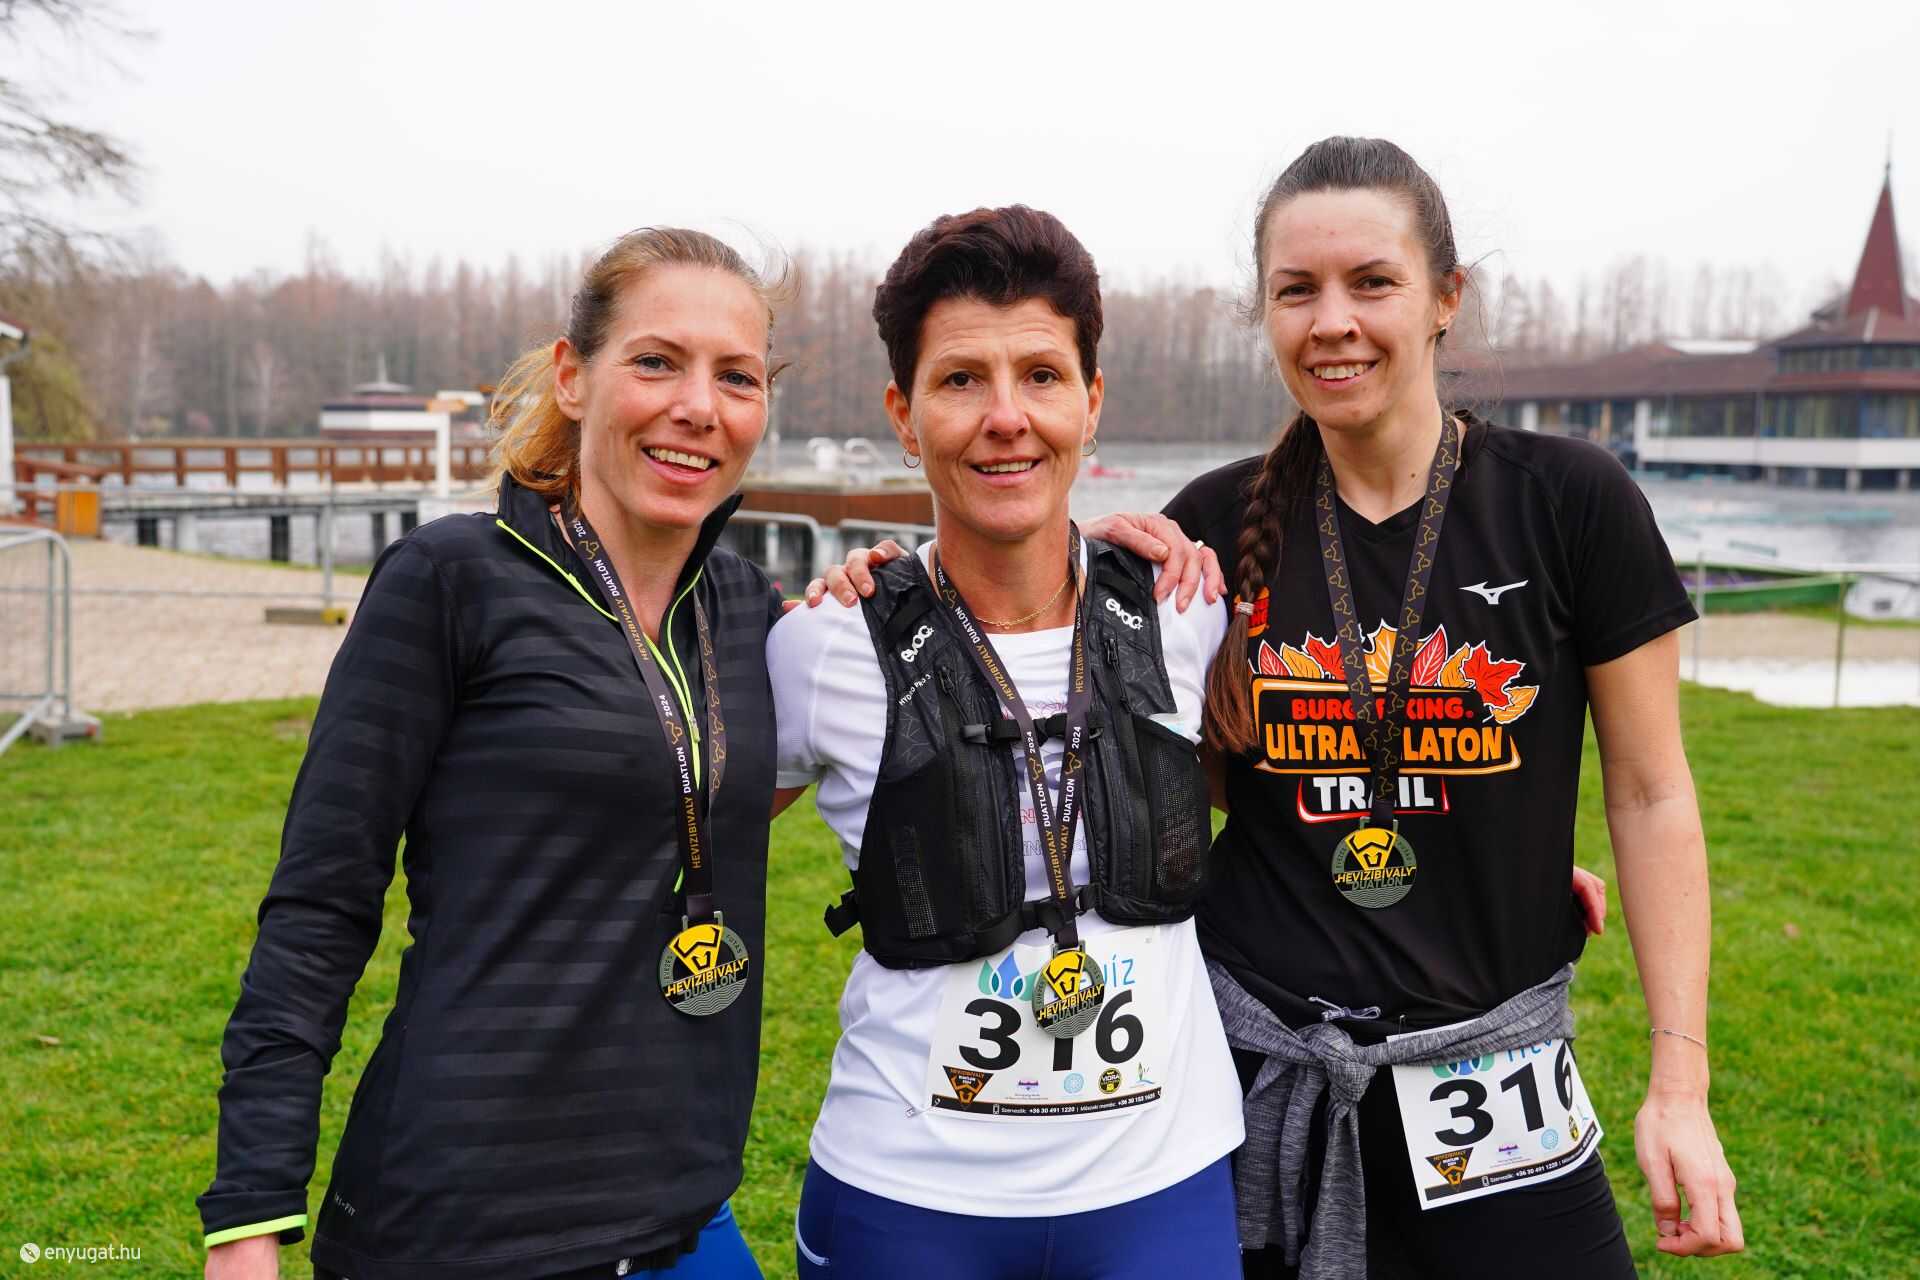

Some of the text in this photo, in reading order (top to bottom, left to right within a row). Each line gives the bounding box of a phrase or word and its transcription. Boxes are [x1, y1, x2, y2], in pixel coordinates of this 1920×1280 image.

[593, 559, 620, 597] DUATLON
[955, 606, 981, 644] DUATLON
[976, 642, 1015, 700] HEVIZIBIVALY
[1291, 697, 1385, 720] BURG
[1026, 731, 1036, 754] 2024
[1265, 724, 1503, 762] ULTRALATON
[659, 694, 700, 869] HEVIZIBIVALY DUATLON 2024
[1063, 778, 1076, 822] DUATLON
[1071, 726, 1082, 749] 2024
[1037, 783, 1051, 826] DUATLON
[1045, 830, 1067, 899] HEVIZIBIVALY
[1334, 866, 1416, 884] HEVIZIBIVALY
[1352, 877, 1403, 890] DUATLON
[665, 957, 749, 997] HEVIZIBIVALY
[684, 973, 737, 1000] DUATLON
[1038, 983, 1105, 1021] HEVIZIBIVALY
[1052, 1000, 1095, 1024] DUATLON
[1430, 1041, 1574, 1147] 316
